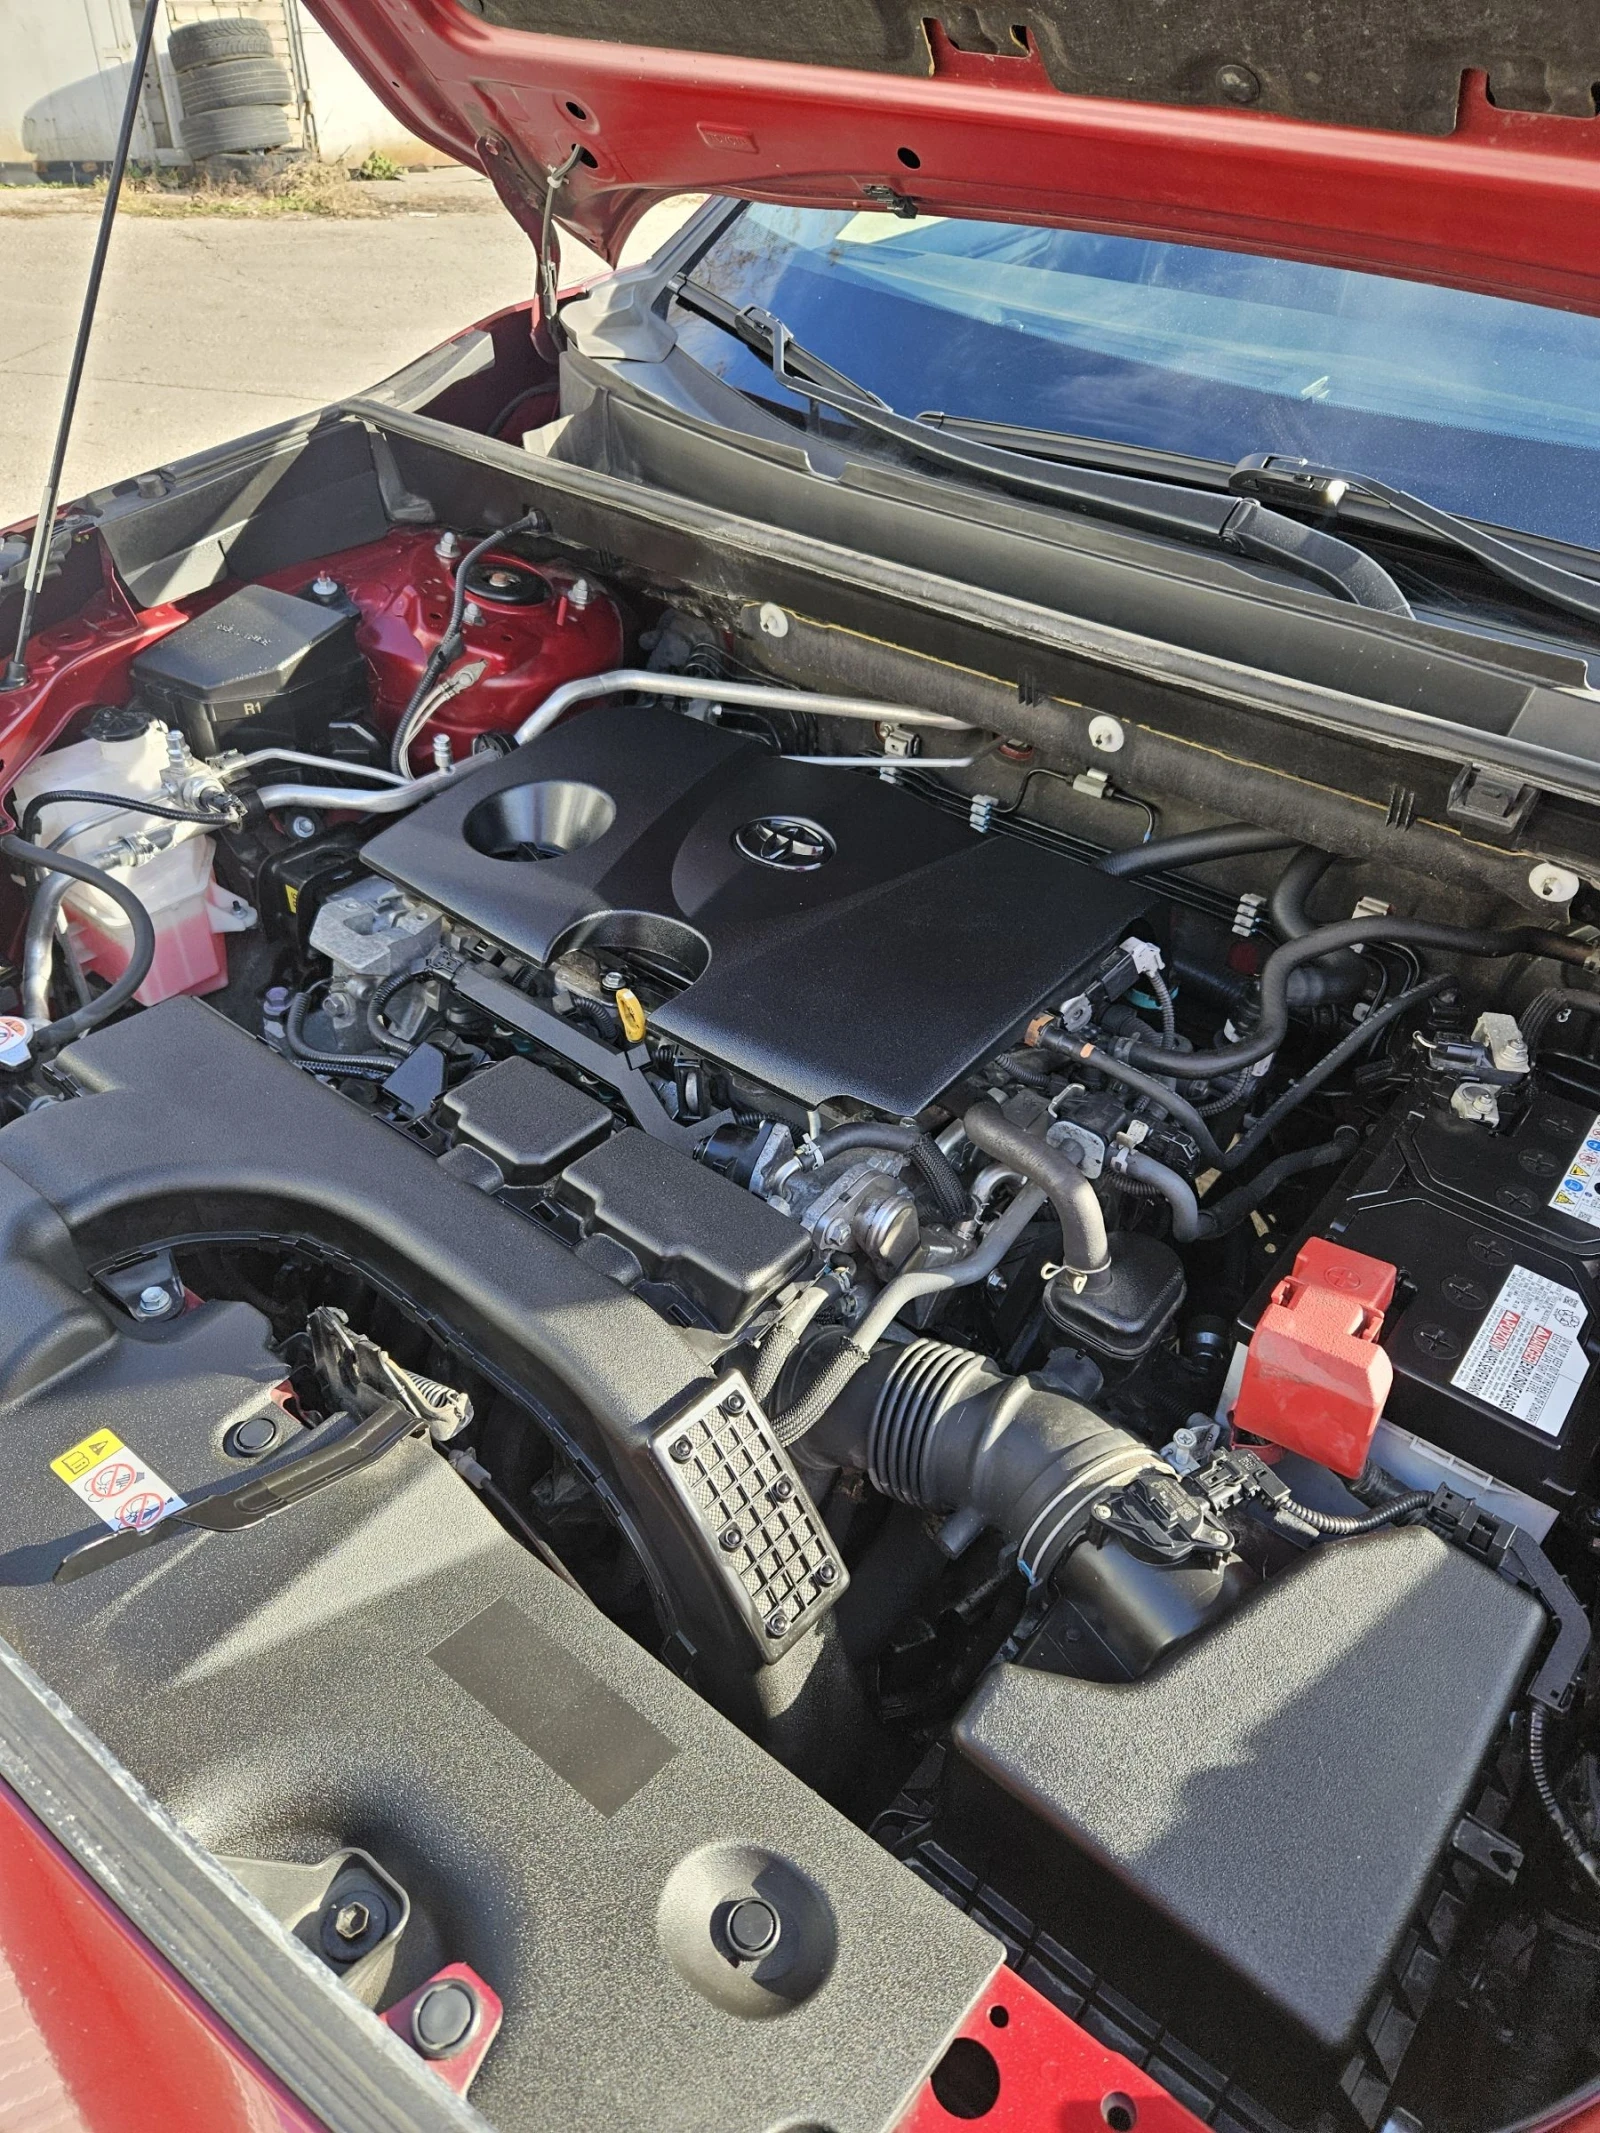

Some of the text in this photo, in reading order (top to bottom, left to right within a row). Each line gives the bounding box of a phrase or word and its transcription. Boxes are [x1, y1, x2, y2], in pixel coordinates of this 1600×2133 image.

[243, 702, 263, 716] R1
[1521, 1332, 1548, 1365] DANGER
[1507, 1360, 1534, 1393] EXPLOSIVE
[1497, 1388, 1520, 1412] GASES
